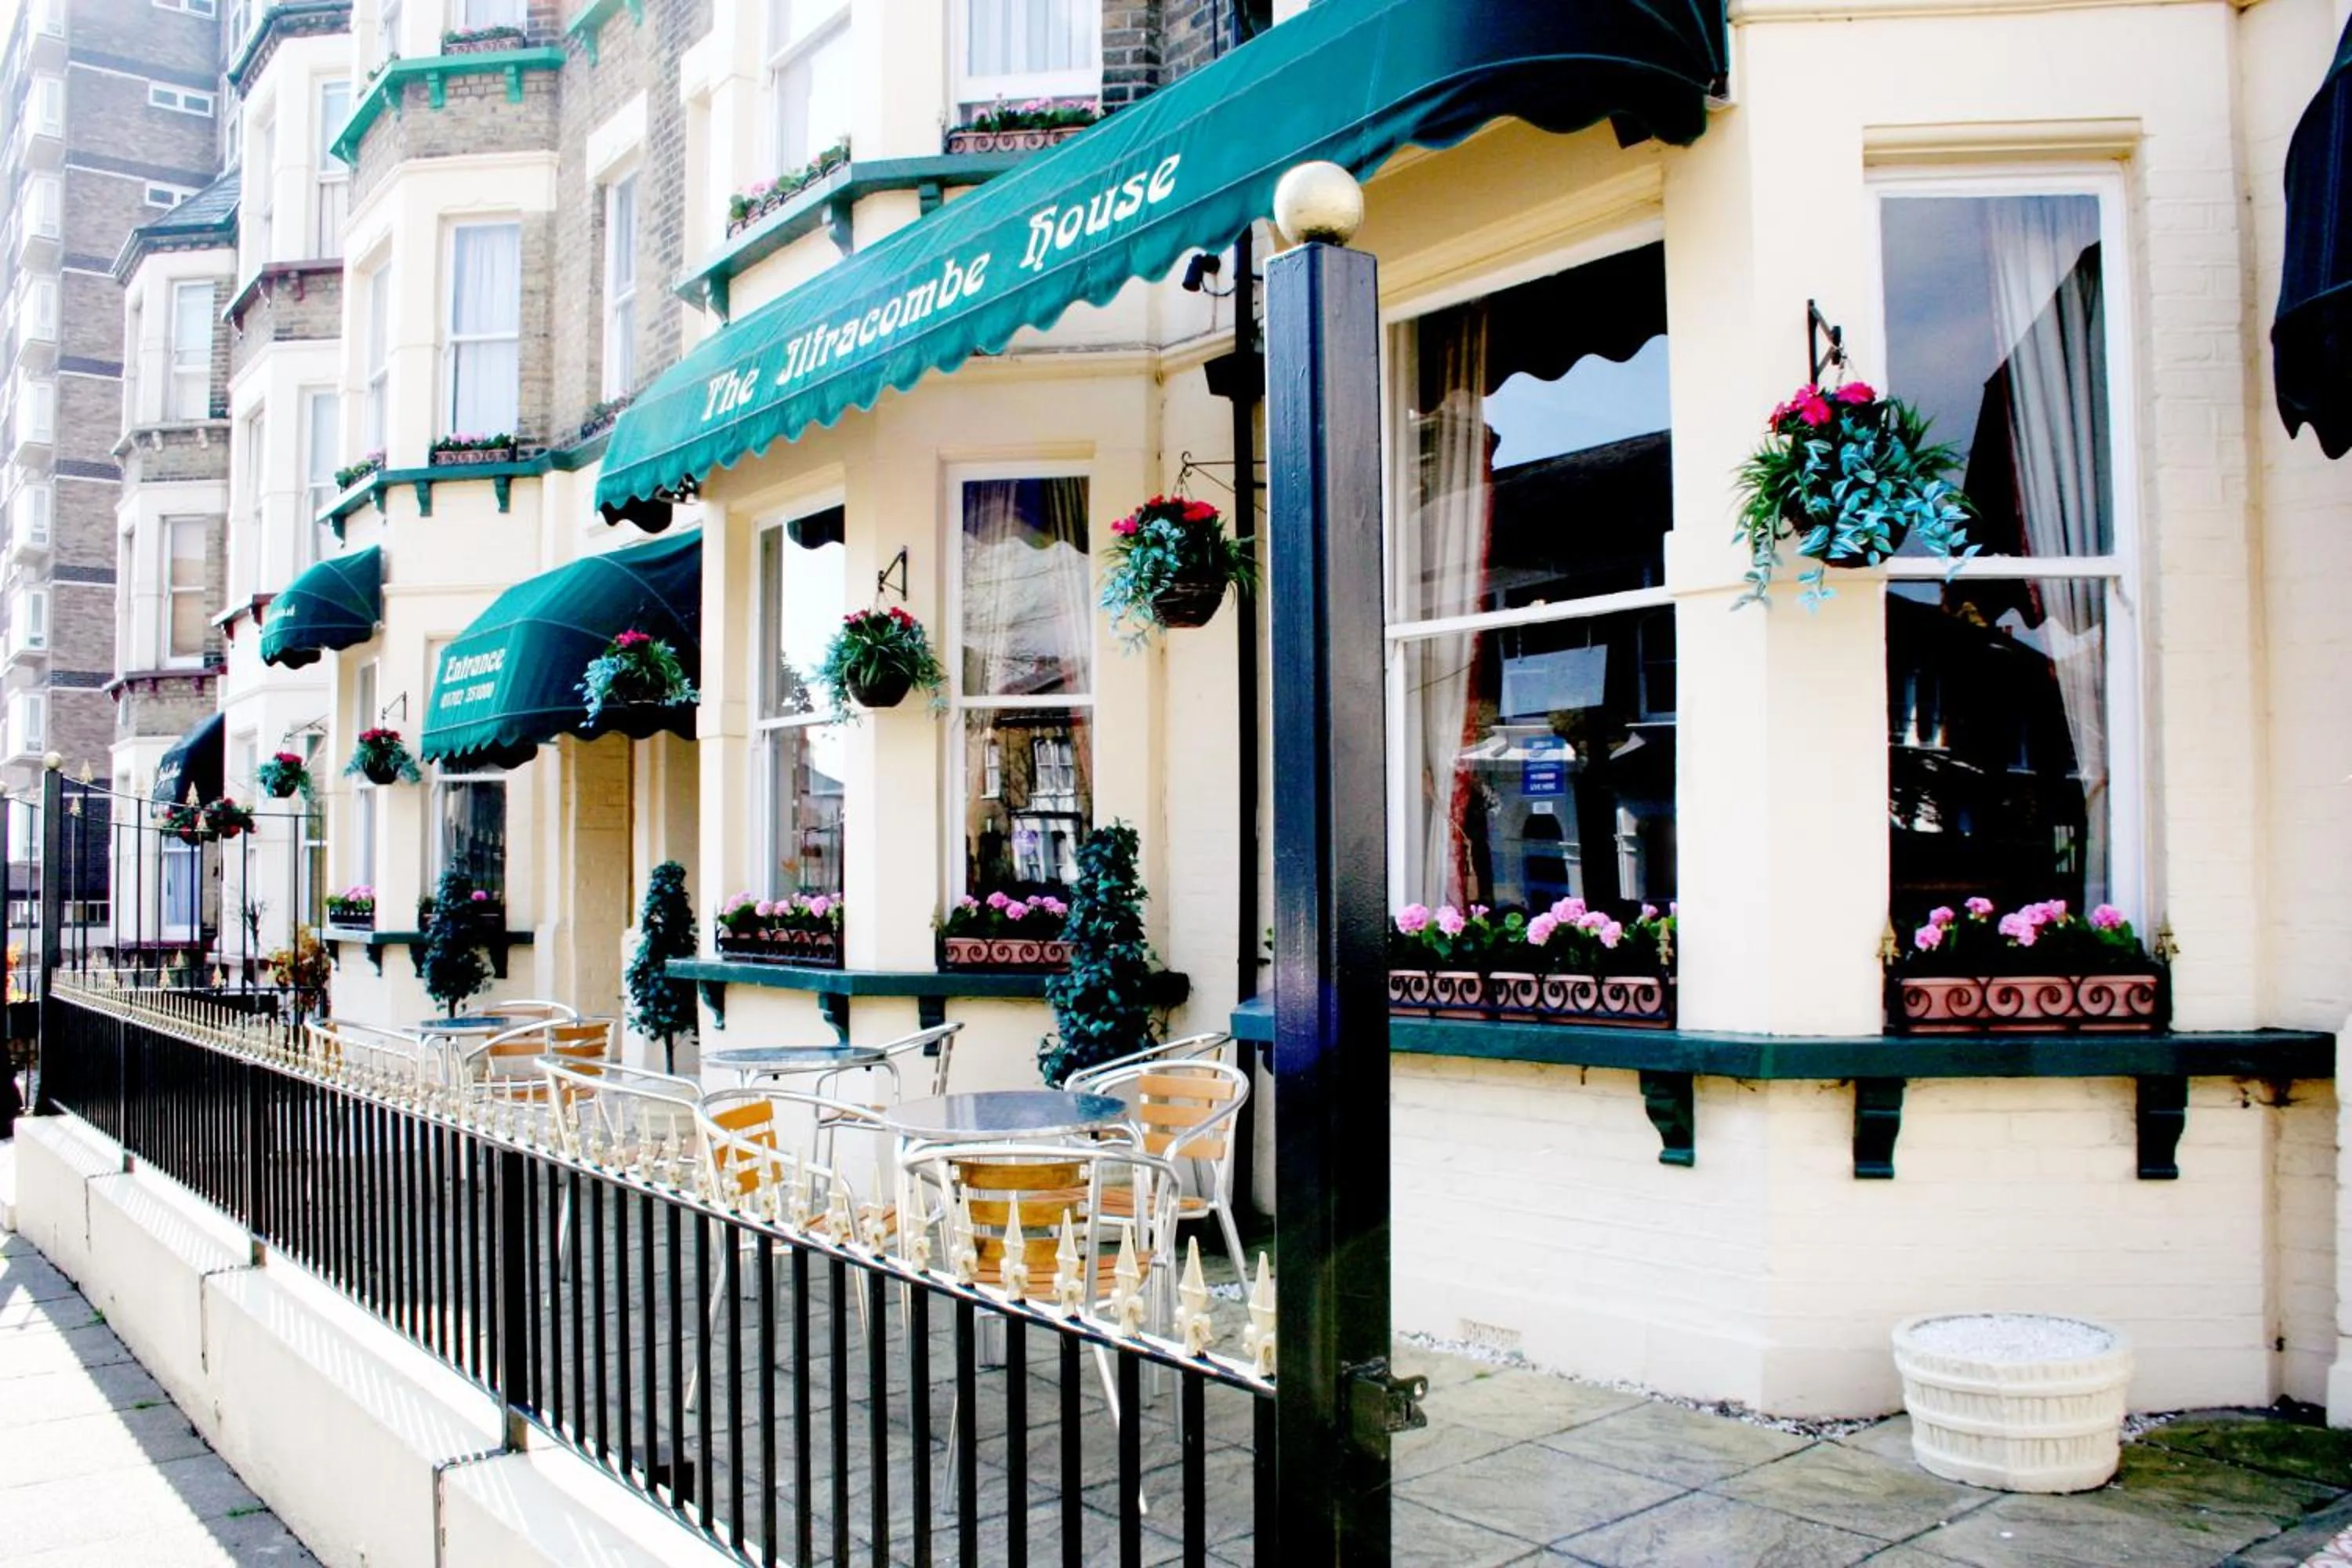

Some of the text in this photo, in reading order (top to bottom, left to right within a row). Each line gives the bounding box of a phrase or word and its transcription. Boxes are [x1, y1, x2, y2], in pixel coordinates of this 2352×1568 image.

[702, 154, 1180, 421] The Ilfracombe House
[442, 649, 506, 684] Entrance
